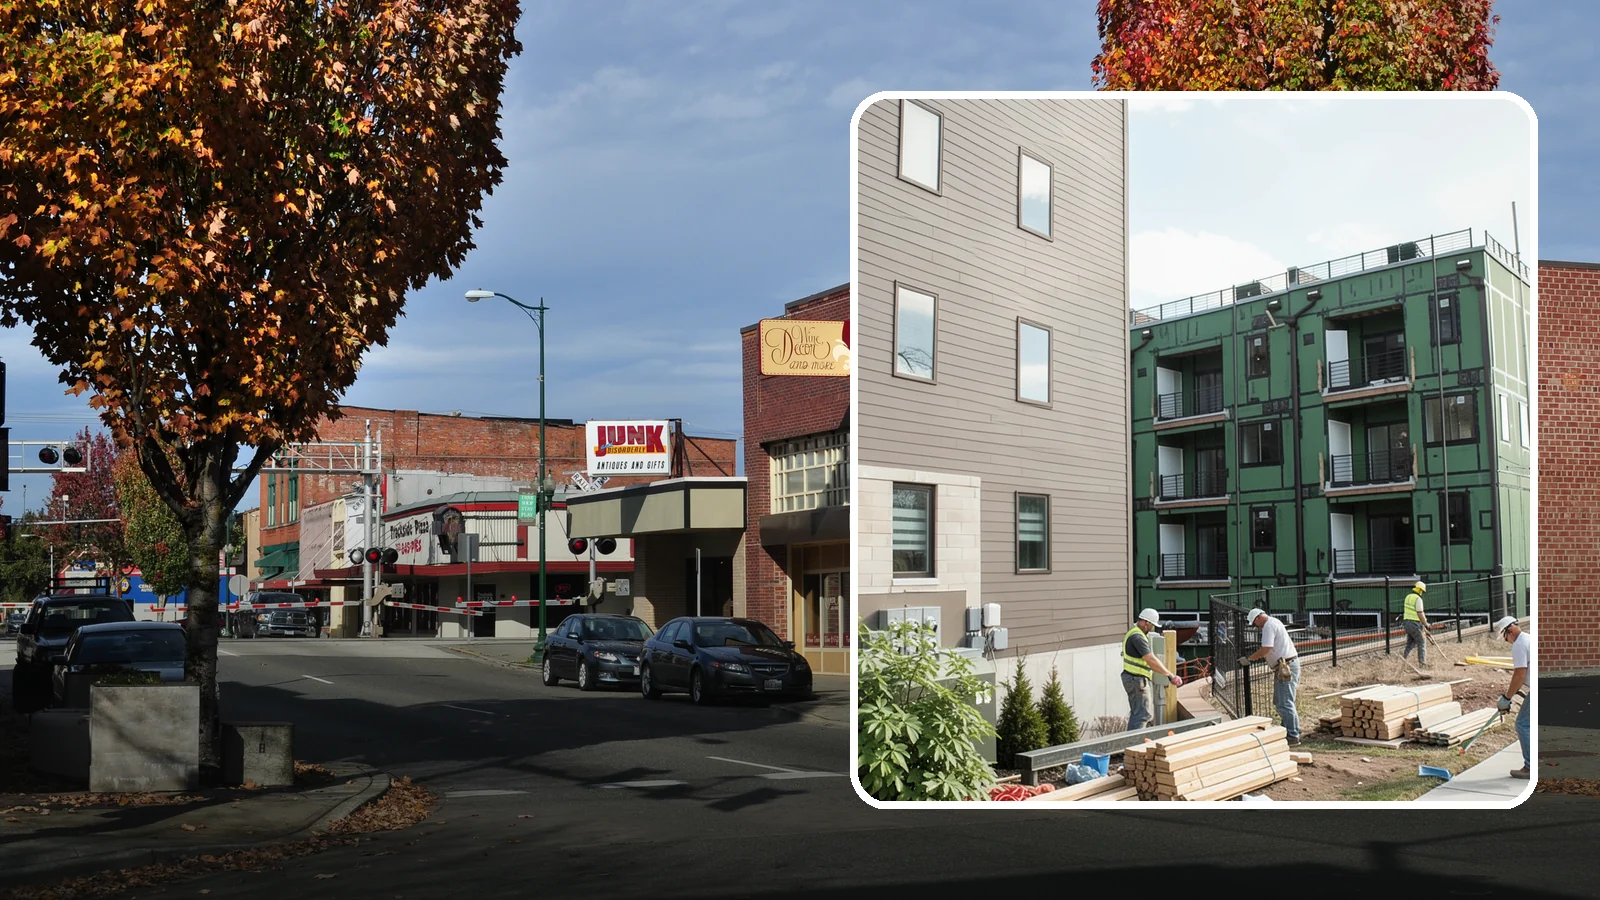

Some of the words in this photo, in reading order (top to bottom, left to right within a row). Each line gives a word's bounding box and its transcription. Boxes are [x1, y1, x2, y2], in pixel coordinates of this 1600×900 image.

[765, 328, 831, 365] Decor
[595, 425, 665, 457] JUNK
[607, 446, 646, 454] DISORDERLY
[597, 461, 628, 470] ANTIQUES
[631, 461, 644, 470] AND
[647, 460, 665, 469] GIFTS
[390, 521, 413, 539] Trackside
[414, 519, 429, 535] Pizza
